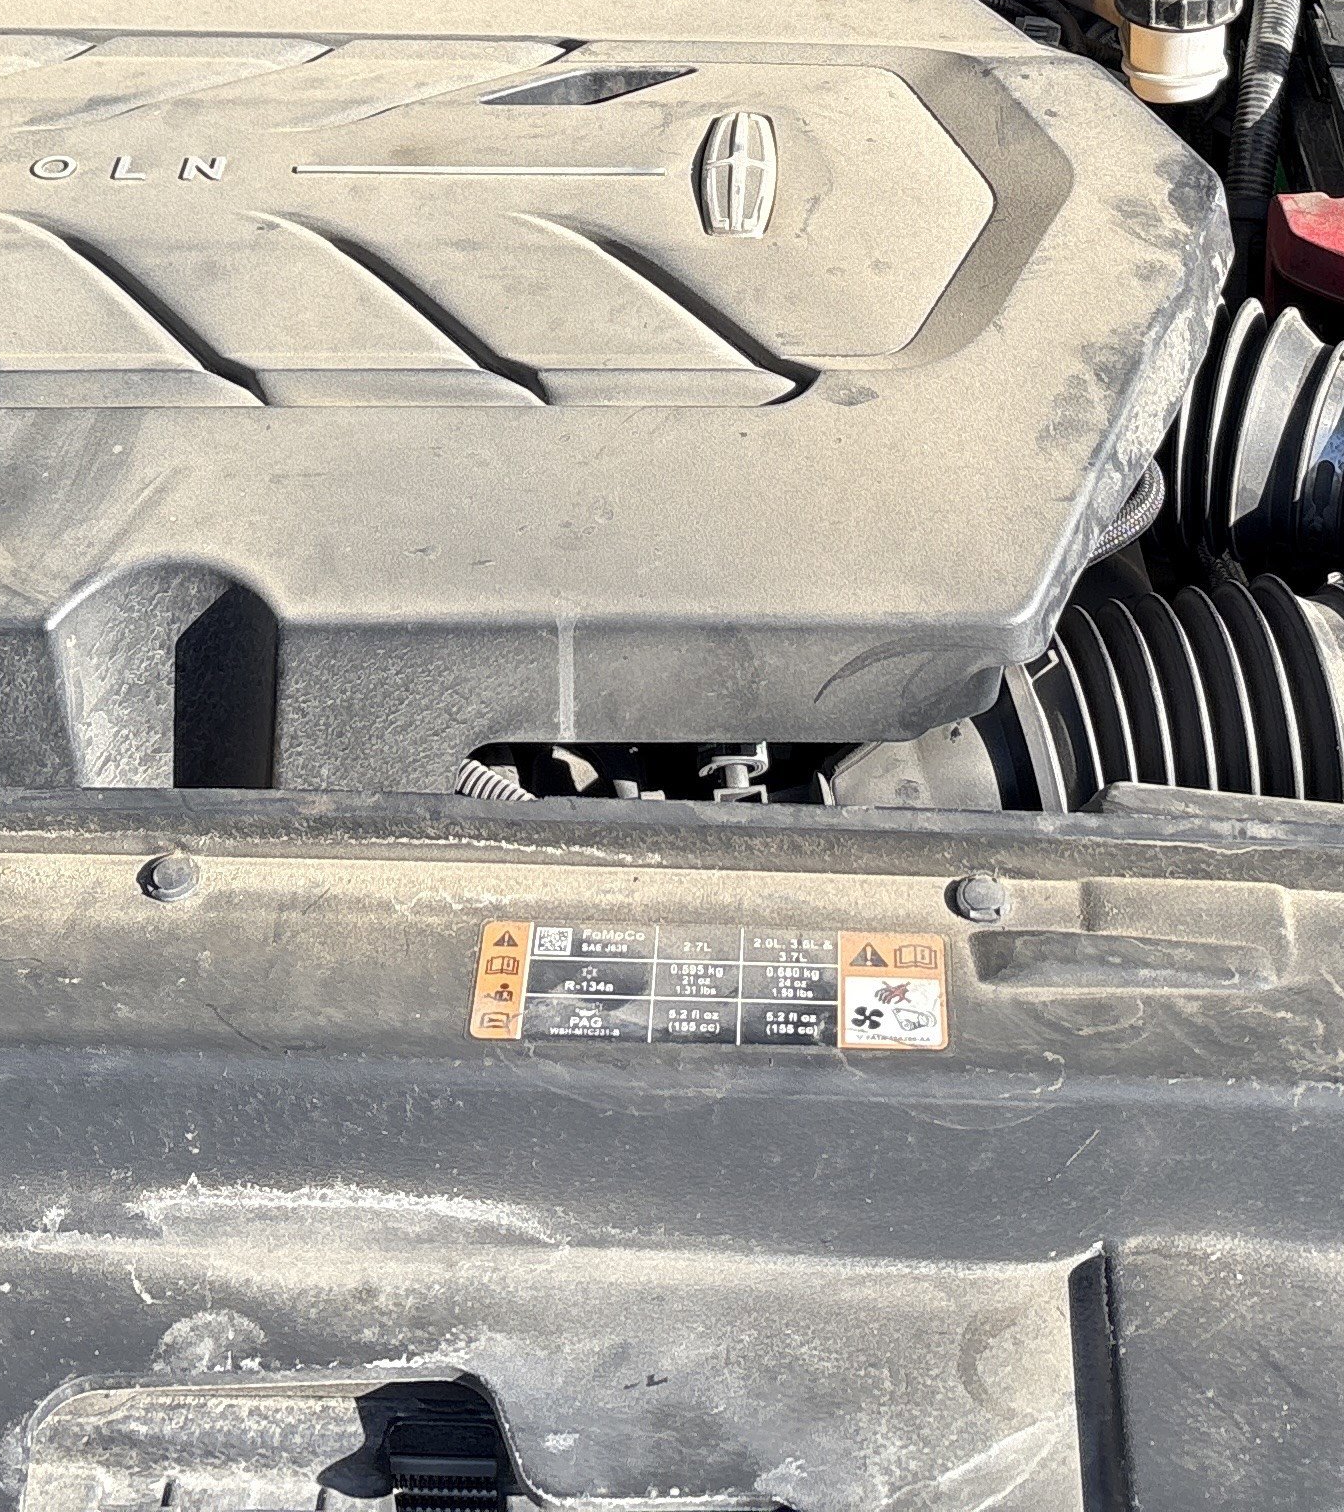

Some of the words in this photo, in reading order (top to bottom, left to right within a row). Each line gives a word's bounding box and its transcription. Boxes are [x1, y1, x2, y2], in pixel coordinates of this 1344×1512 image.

[582, 929, 645, 940] FoMoCo
[581, 942, 602, 952] SAE
[683, 942, 712, 952] 2.7L
[778, 952, 807, 962] 3.7L
[707, 965, 724, 978] kg
[803, 968, 820, 980] kg
[682, 976, 694, 985] 21
[778, 978, 791, 987] 24
[564, 980, 614, 992] R-134a
[699, 985, 717, 995] lbs
[796, 988, 814, 998] lbs
[703, 1011, 720, 1020] oz
[800, 1014, 817, 1023] oz
[569, 1016, 603, 1028] PAG
[699, 1022, 720, 1034] cc)
[797, 1025, 818, 1036] cc)
